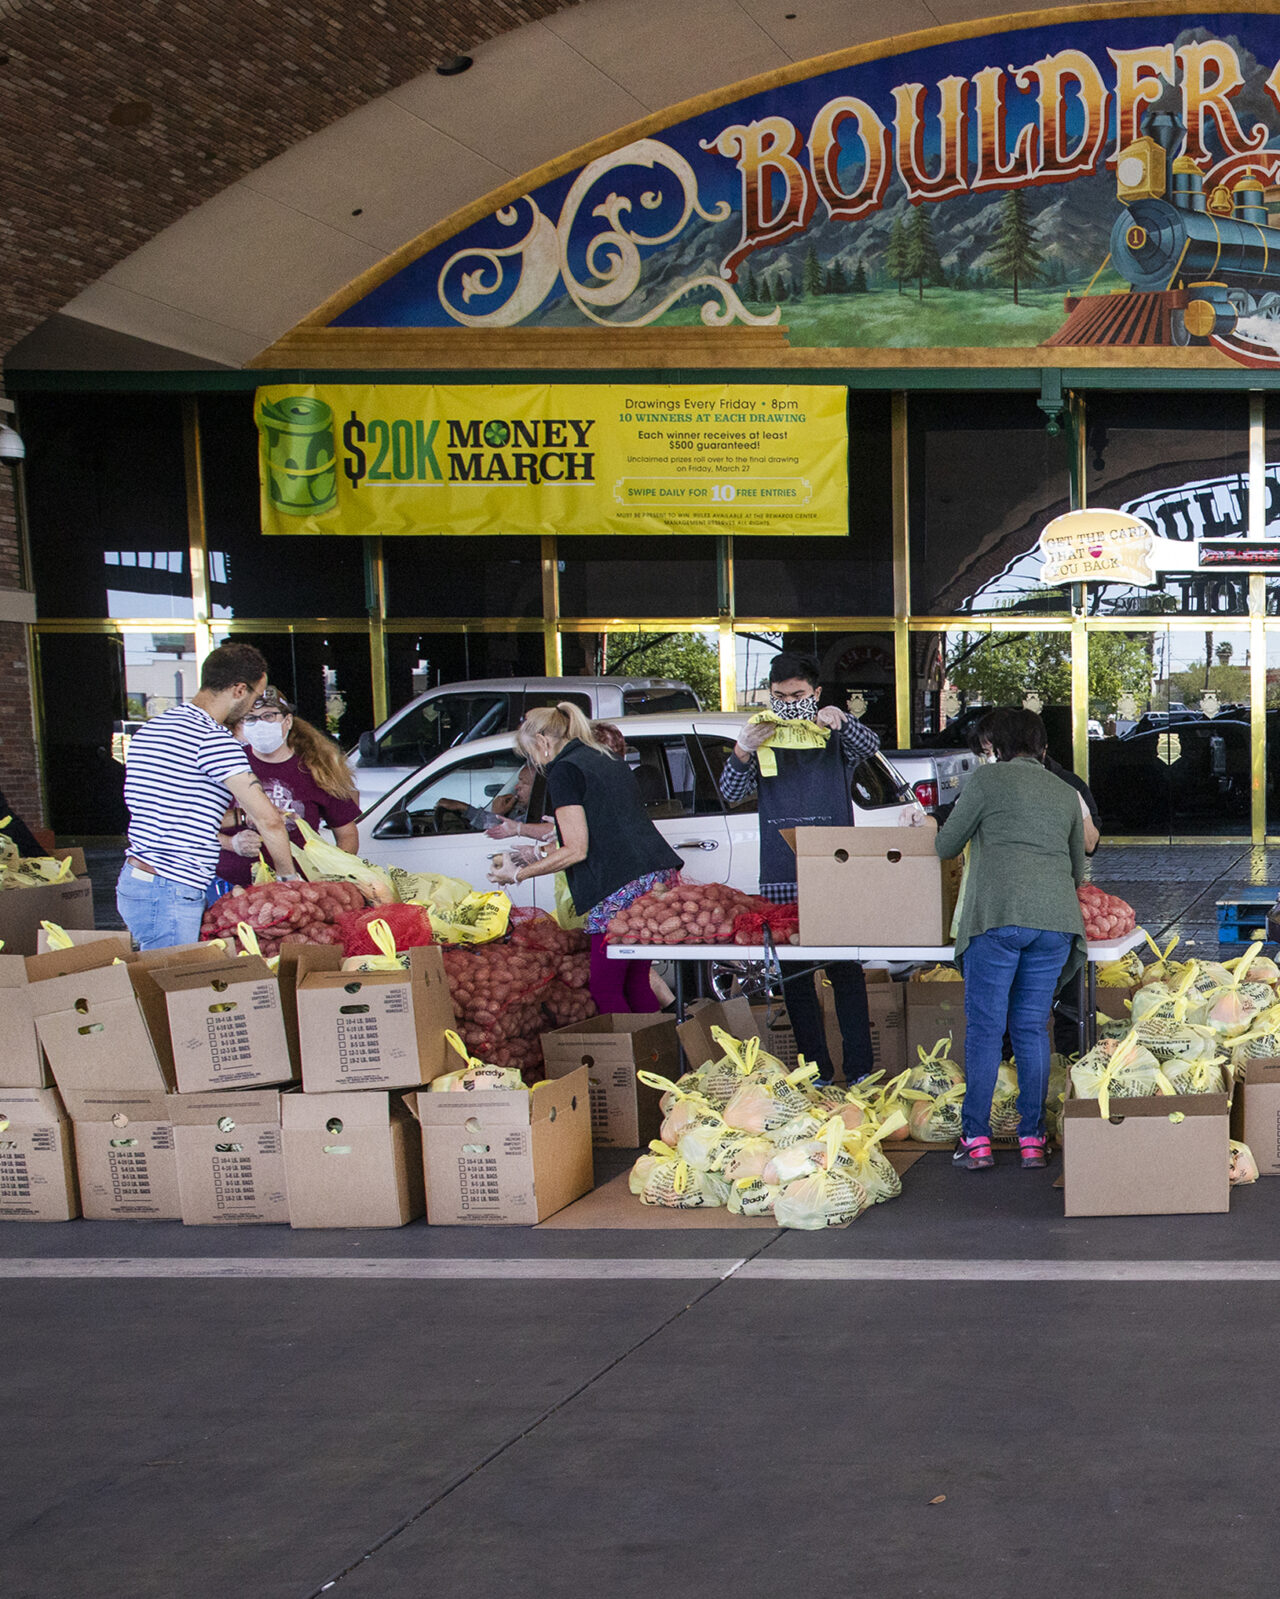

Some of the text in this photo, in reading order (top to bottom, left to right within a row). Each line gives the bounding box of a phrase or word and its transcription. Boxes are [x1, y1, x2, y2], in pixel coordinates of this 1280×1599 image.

[695, 40, 1270, 278] BOULDER
[625, 399, 799, 412] Drawings Every Friday 8pm
[619, 413, 806, 423] 10 WINNERS AT EACH DRAWING
[446, 420, 596, 449] MONEY
[638, 431, 788, 440] Each winner receives at least
[343, 411, 443, 489] $20K
[669, 441, 761, 451] $500 guaranteed!
[670, 456, 691, 464] prizes
[768, 456, 799, 464] drawing
[447, 452, 596, 485] MARCH
[688, 465, 713, 473] Friday,
[628, 484, 797, 502] SWIPE DAILY FOR 10 FREE ENTRIES
[1046, 526, 1148, 547] GET THE CARD
[1049, 548, 1085, 562] THAT
[1083, 558, 1121, 572] BACK
